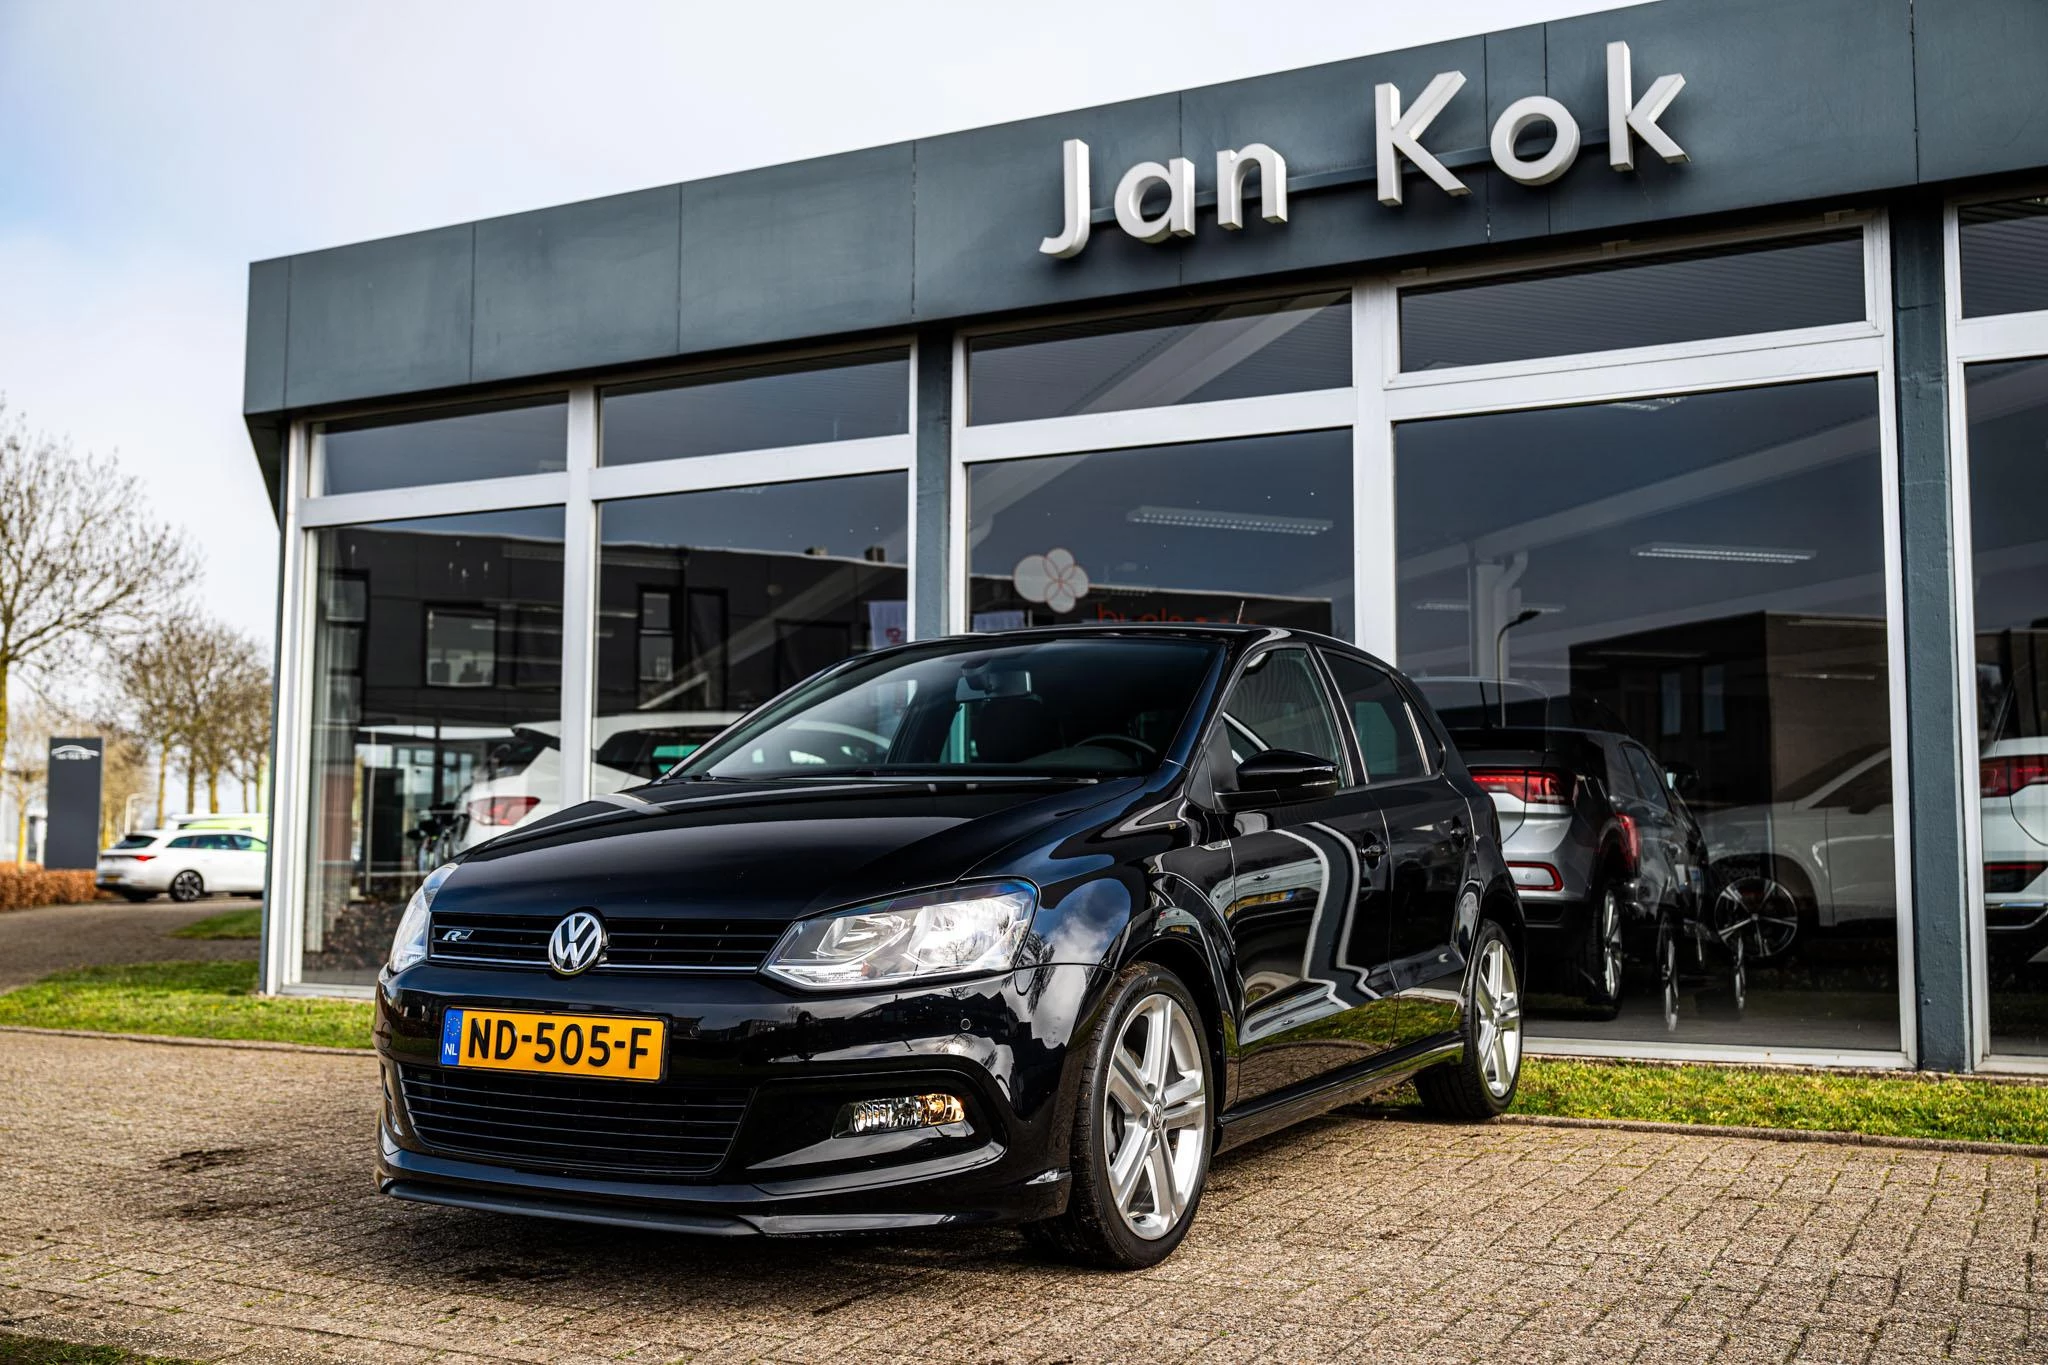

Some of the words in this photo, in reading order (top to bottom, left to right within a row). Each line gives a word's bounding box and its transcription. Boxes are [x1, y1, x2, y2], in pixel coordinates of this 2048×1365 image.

[1038, 138, 1289, 259] Jan
[1374, 40, 1692, 207] Kok
[445, 1043, 457, 1056] NL
[468, 1017, 653, 1070] ND-505-F
